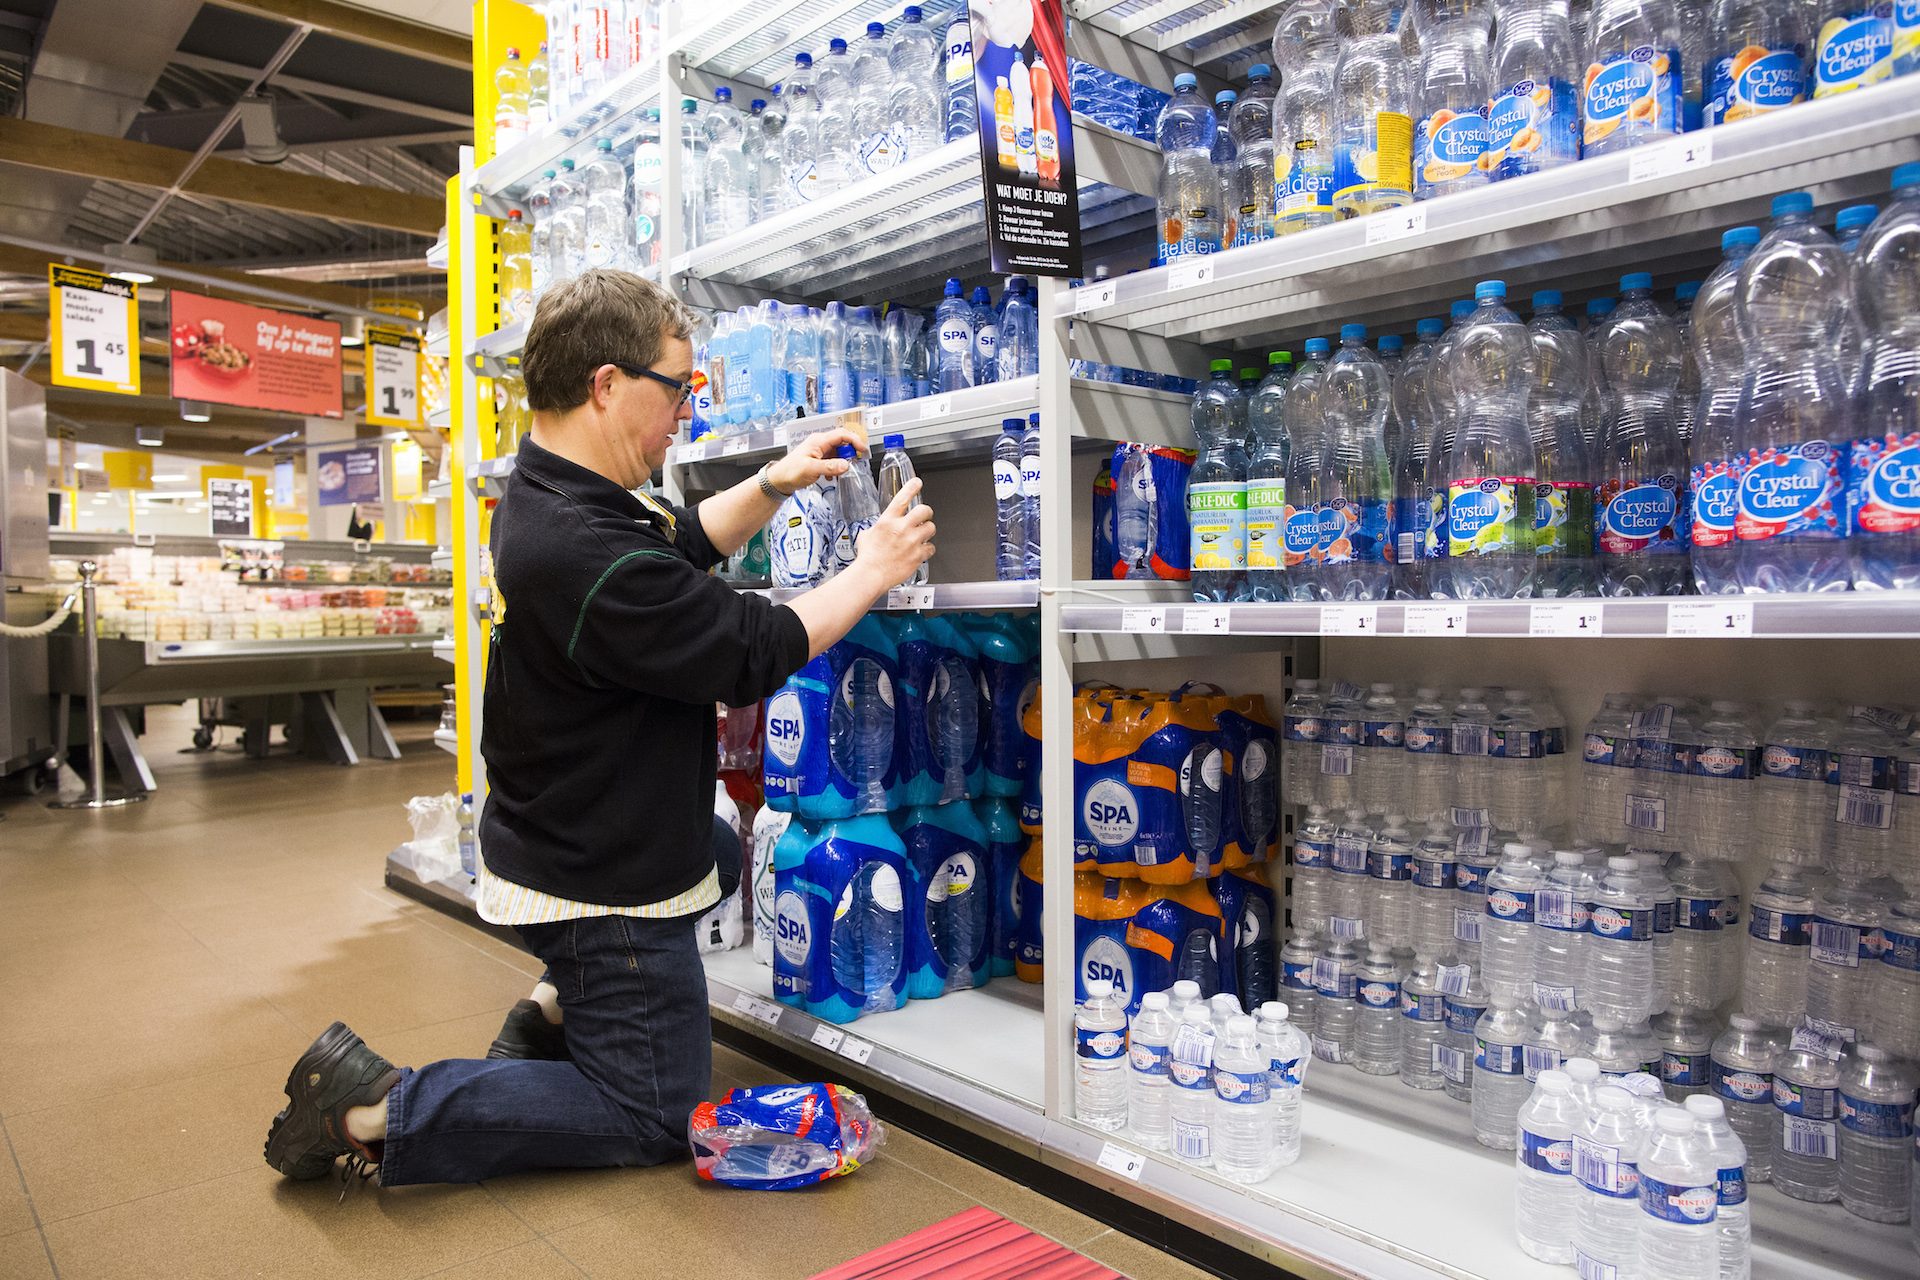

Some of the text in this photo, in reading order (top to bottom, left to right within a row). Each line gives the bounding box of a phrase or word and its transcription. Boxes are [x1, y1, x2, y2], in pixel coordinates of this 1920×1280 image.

[1823, 26, 1890, 63] Crystal
[1828, 54, 1875, 76] Clear
[1589, 70, 1647, 103] Crystal
[1754, 82, 1794, 97] Clear
[1594, 94, 1632, 114] Clear
[1445, 141, 1480, 156] Clear
[1686, 149, 1695, 162] 1
[996, 184, 1068, 206] WAT MOET JE DOEN?
[1002, 204, 1013, 215] Koop
[1406, 218, 1415, 229] 1
[1159, 238, 1216, 259] Helder
[1198, 269, 1204, 279] 0
[1103, 292, 1108, 301] 0
[66, 303, 104, 314] mosterd
[66, 313, 95, 323] salade
[256, 321, 334, 346] Om je vingers
[943, 331, 968, 341] SPA
[274, 341, 290, 353] op
[291, 344, 304, 354] te
[76, 339, 125, 375] 1 45
[383, 387, 415, 415] 1 99
[993, 473, 1014, 485] SPA
[1746, 469, 1819, 494] Crystal
[1613, 497, 1671, 517] Crystal
[1752, 493, 1801, 508] Clear
[1450, 500, 1493, 521] Crystal
[1452, 518, 1480, 531] Clear
[1620, 514, 1659, 528] Clear
[1288, 534, 1313, 545] Clear
[1608, 541, 1634, 550] Cherry
[1150, 617, 1157, 627] 0
[1214, 618, 1220, 627] 1
[1358, 617, 1366, 628] 1
[1447, 617, 1454, 628] 1
[1579, 617, 1587, 628] 1
[1725, 615, 1735, 628] 1
[770, 718, 800, 741] SPA
[1090, 801, 1132, 824] SPA
[777, 913, 807, 944] SPA
[1087, 960, 1127, 993] SPA
[1723, 1077, 1773, 1090] CRISTALINE
[1127, 1162, 1134, 1171] 0
